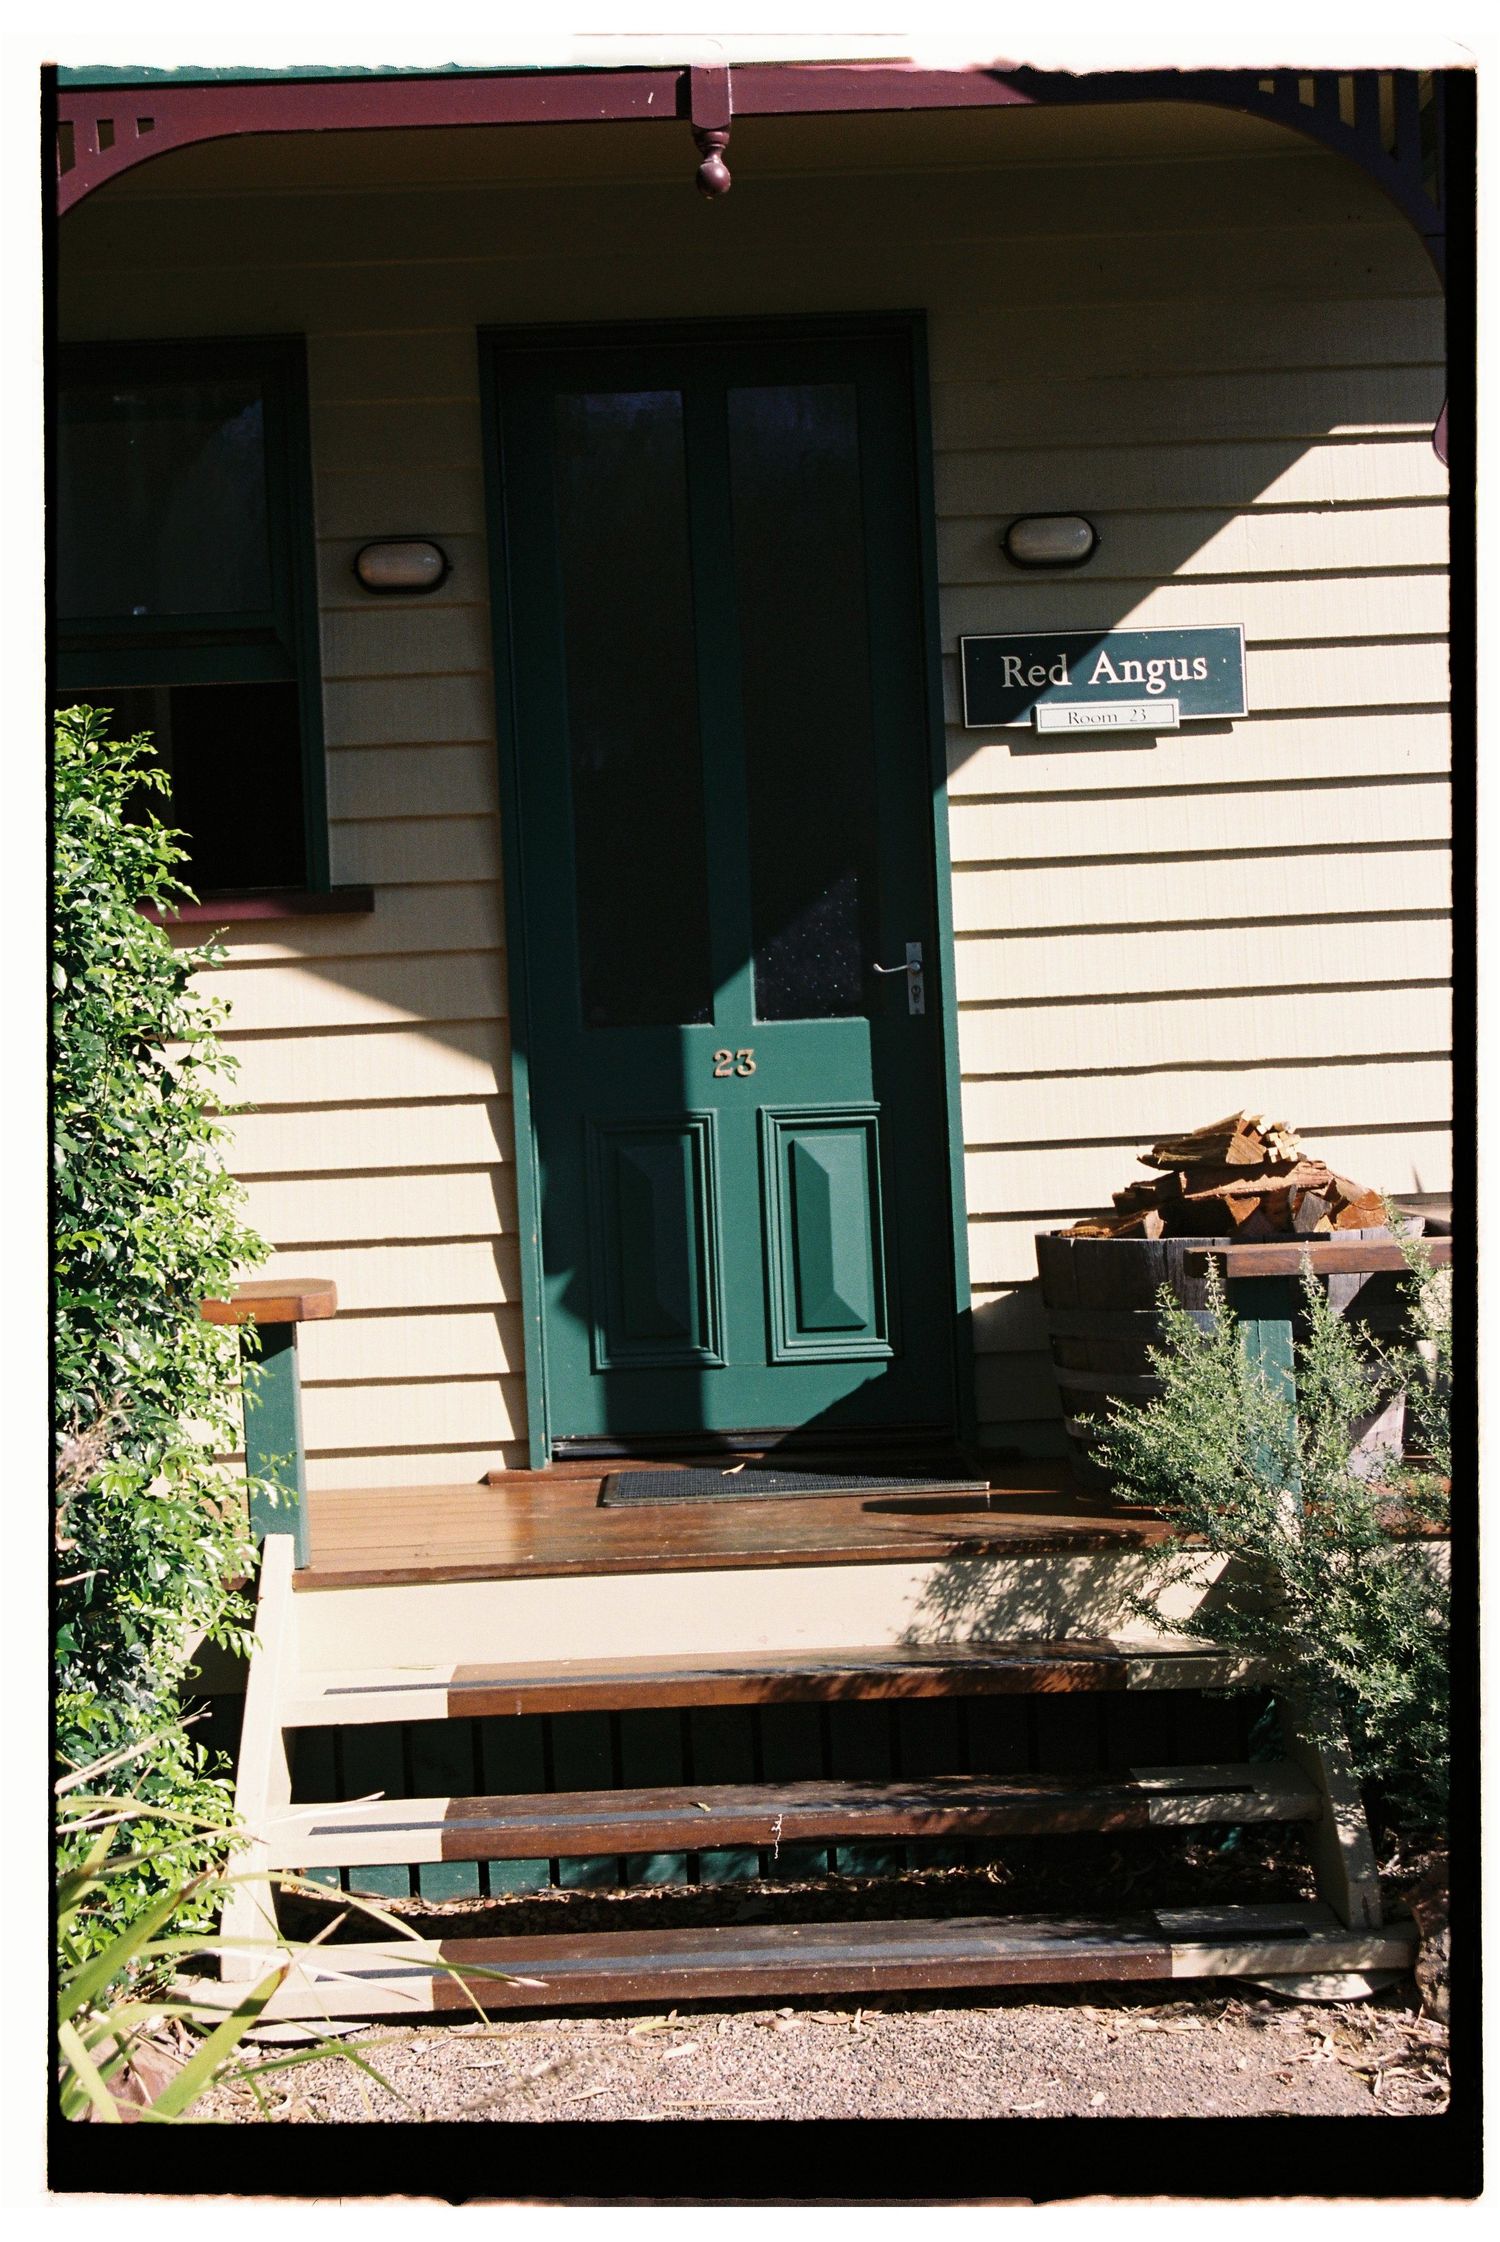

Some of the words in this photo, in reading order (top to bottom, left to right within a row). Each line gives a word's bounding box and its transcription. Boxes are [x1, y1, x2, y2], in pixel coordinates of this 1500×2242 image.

[1001, 654, 1072, 688] Red
[1088, 650, 1207, 695] Angus
[1067, 709, 1118, 725] Room
[1129, 708, 1147, 723] 23
[713, 1049, 757, 1077] 23
